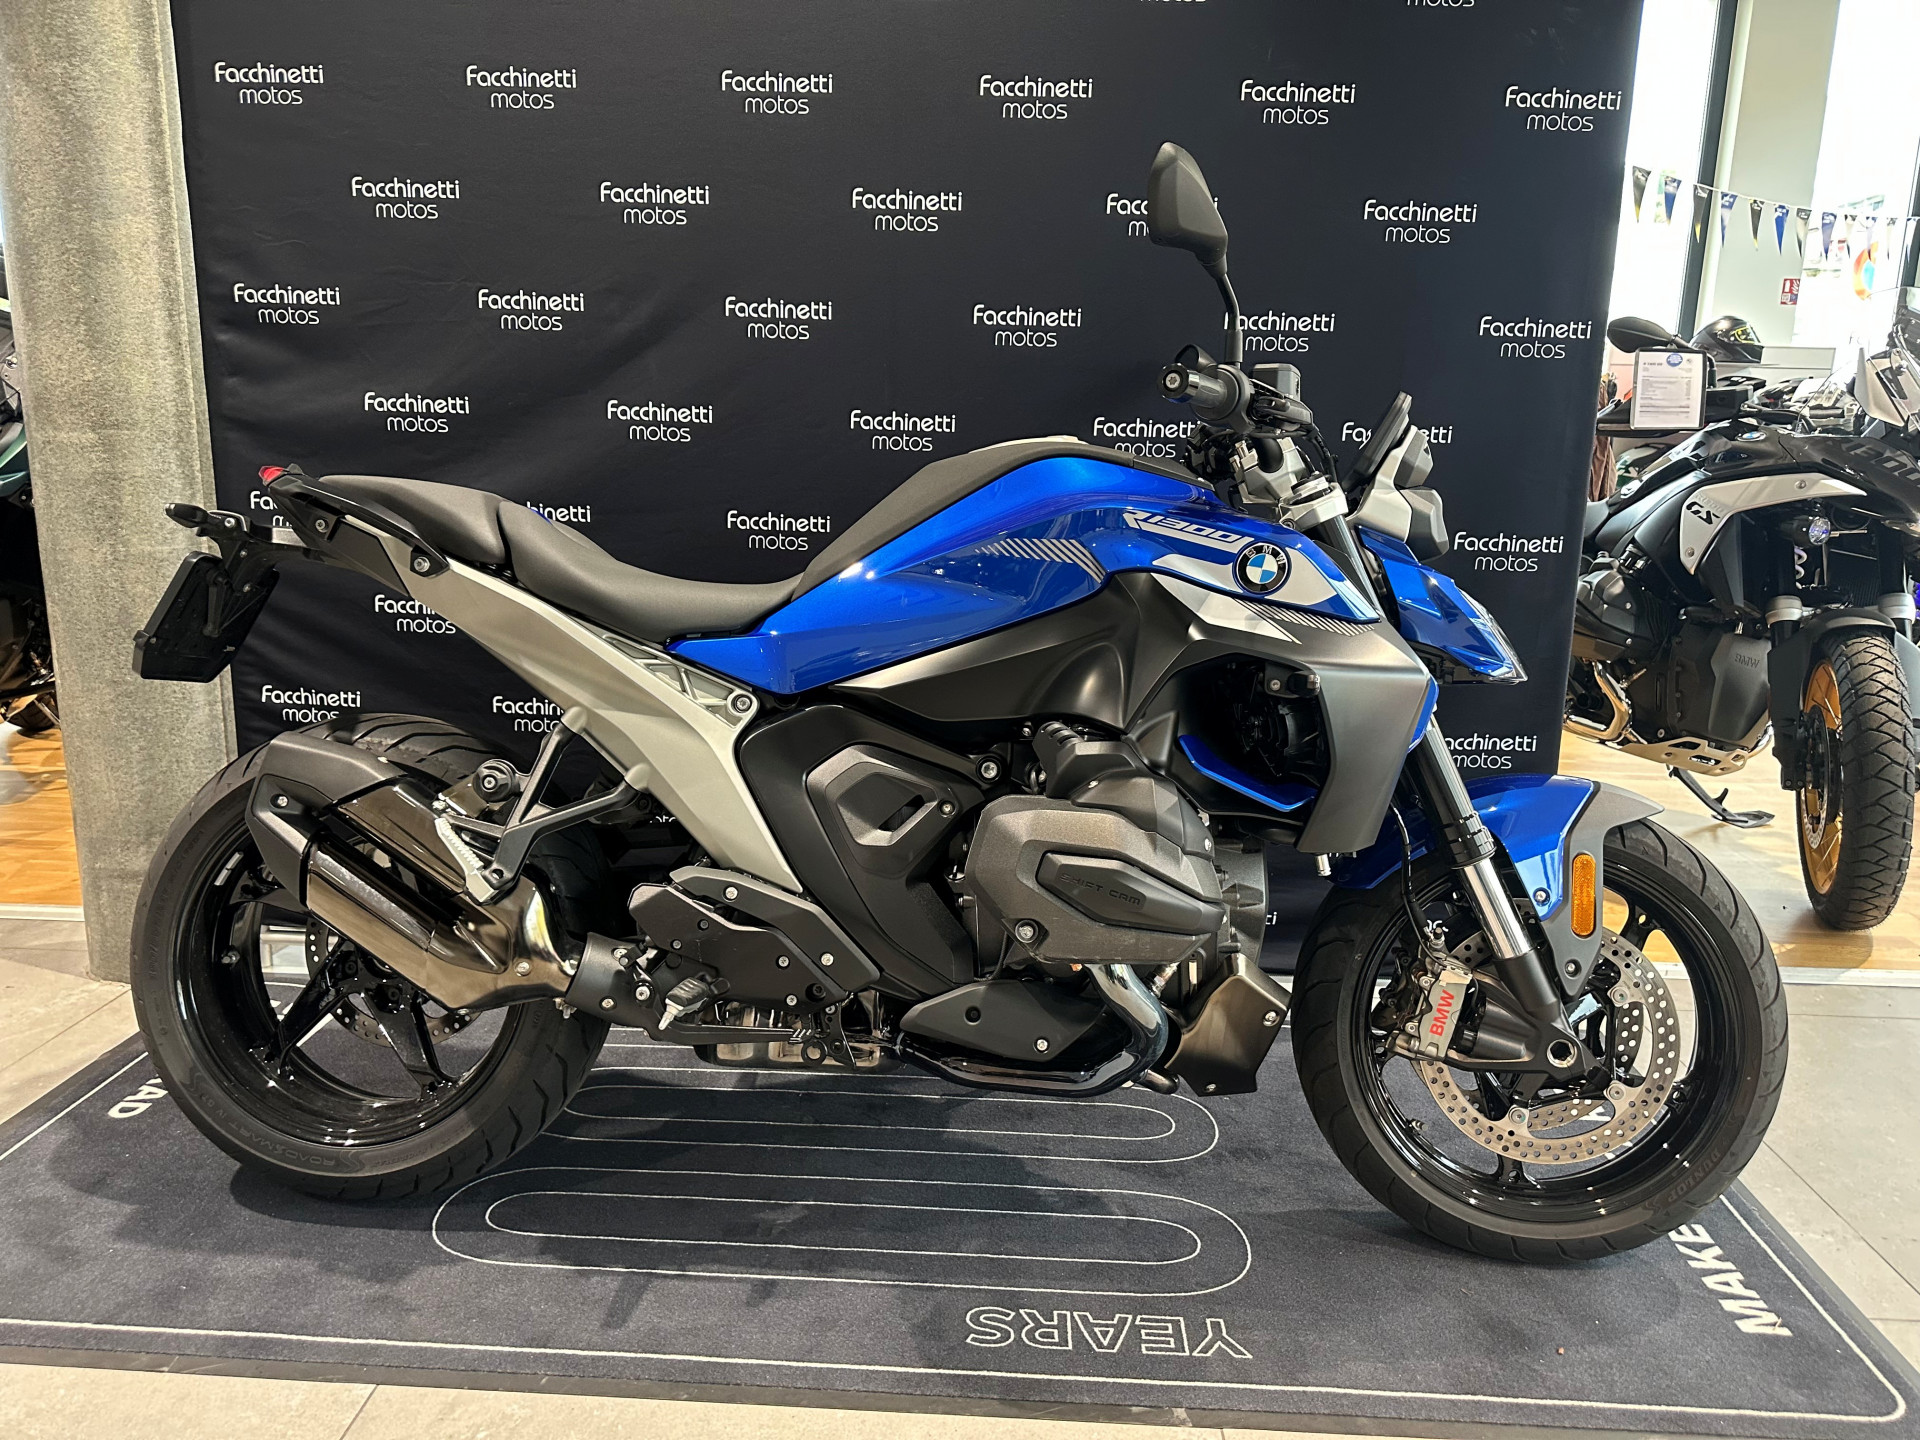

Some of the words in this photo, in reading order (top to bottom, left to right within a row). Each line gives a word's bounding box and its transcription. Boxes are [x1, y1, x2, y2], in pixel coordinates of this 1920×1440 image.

[214, 61, 324, 84] Facchinetti
[466, 64, 577, 89] Facchinetti
[721, 69, 833, 94] Facchinetti
[239, 85, 303, 105] motos
[979, 74, 1093, 99] Facchinetti
[1240, 79, 1356, 104] Facchinetti
[1504, 85, 1623, 111] Facchinetti
[490, 89, 555, 110] motos
[744, 94, 810, 115] motos
[1002, 99, 1068, 120] motos
[1262, 105, 1329, 125] motos
[1526, 111, 1594, 132] motos
[351, 176, 460, 200] Facchinetti
[600, 181, 710, 205] Facchinetti
[852, 187, 963, 212] Facchinetti
[375, 200, 439, 220] motos
[623, 205, 688, 225] motos
[1363, 199, 1478, 223] Facchinetti
[874, 212, 939, 232] motos
[1385, 224, 1451, 244] motos
[233, 282, 341, 306] Facchinetti
[478, 288, 585, 312] Facchinetti
[257, 306, 320, 325] motos
[725, 295, 833, 321] Facchinetti
[973, 303, 1082, 328] Facchinetti
[500, 312, 563, 331] motos
[747, 320, 810, 340] motos
[1479, 315, 1593, 340] Facchinetti
[994, 328, 1058, 348] motos
[1245, 333, 1310, 352] motos
[1500, 340, 1566, 359] motos
[364, 391, 470, 415] Facchinetti
[607, 399, 713, 424] Facchinetti
[386, 414, 449, 433] motos
[850, 409, 956, 433] Facchinetti
[1093, 416, 1201, 438] Facchinett
[629, 423, 692, 443] motos
[871, 433, 933, 452] motos
[1114, 440, 1177, 458] motos
[727, 509, 831, 533] Facchinetti
[1685, 500, 1721, 525] GS
[748, 533, 809, 551] motos
[1453, 531, 1564, 554] Facchinetti
[1474, 554, 1539, 572] motos
[396, 616, 457, 634] motos
[261, 684, 361, 708] Facchinetti
[492, 695, 565, 716] Facchin
[1059, 872, 1104, 893] SHIFT
[1108, 888, 1141, 906] CAM
[1429, 988, 1455, 1037] BMW
[1667, 1147, 1722, 1204] DUNLOP
[1667, 1223, 1794, 1338] MAKE
[965, 1306, 1253, 1359] YEARS
